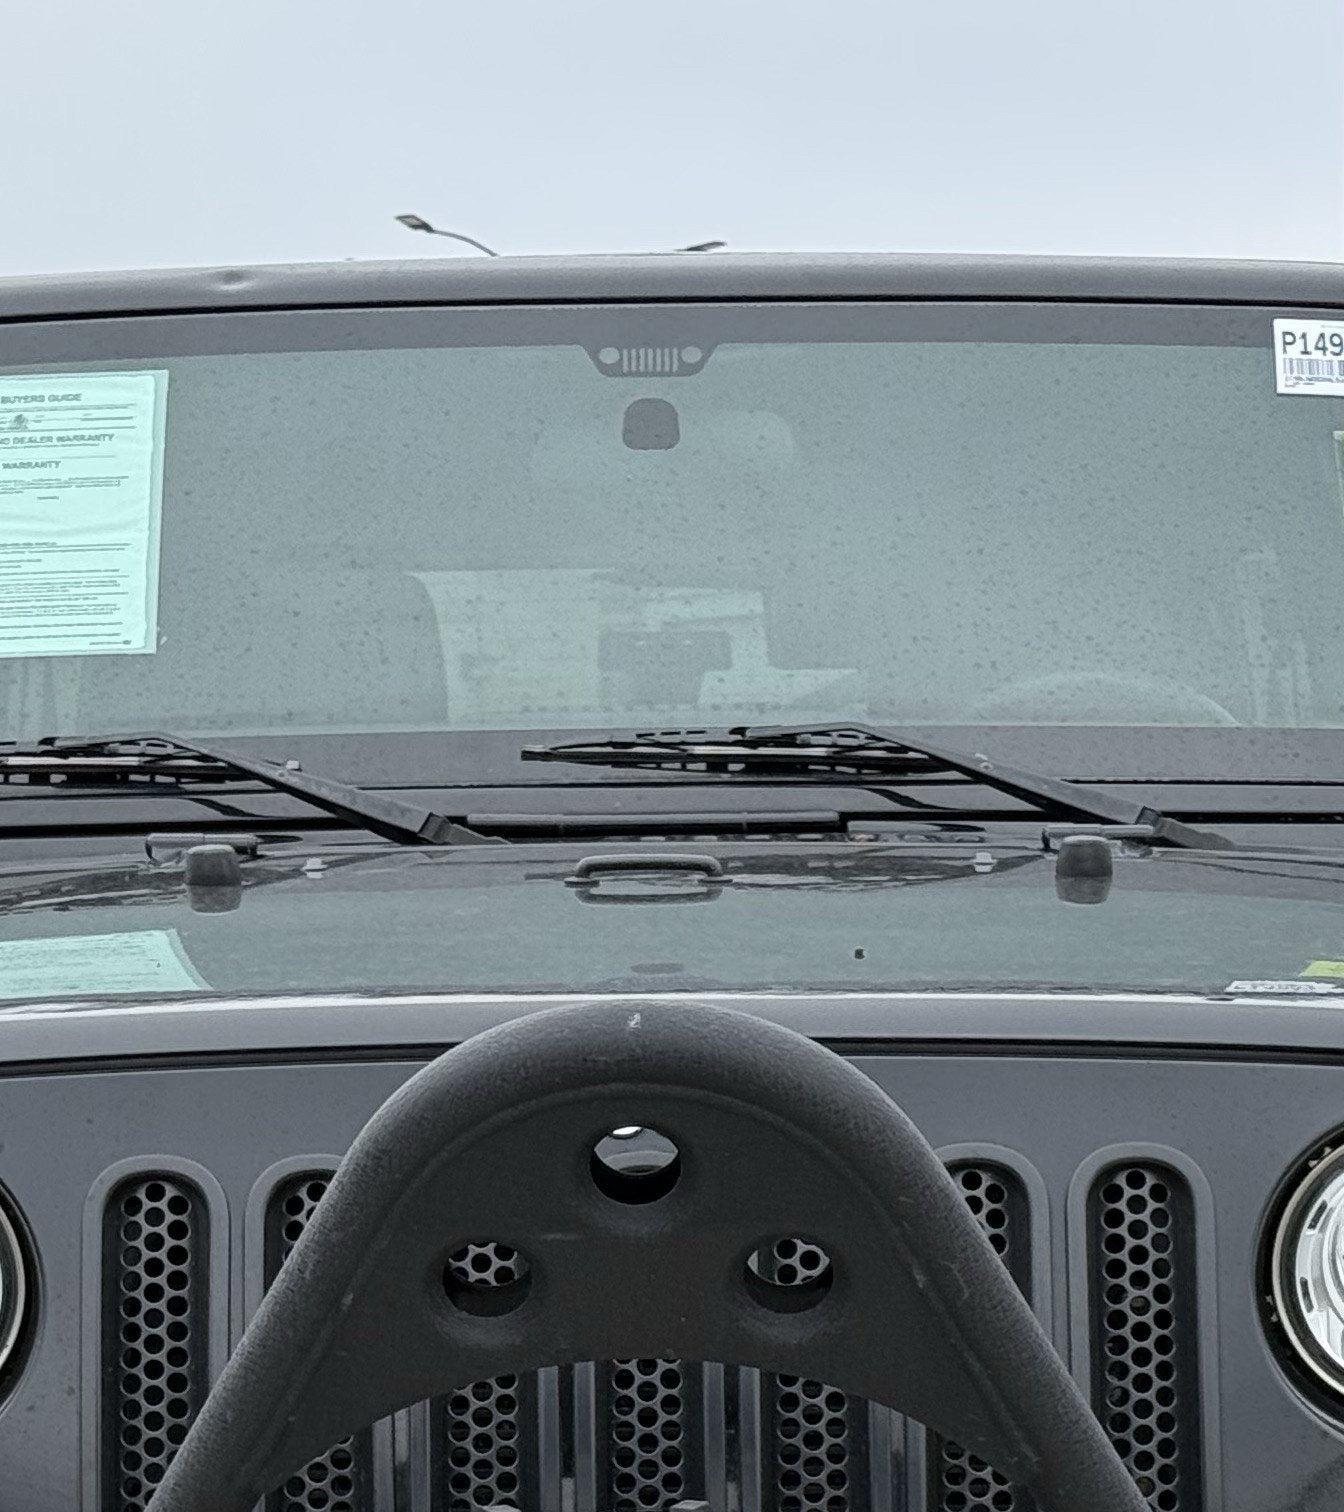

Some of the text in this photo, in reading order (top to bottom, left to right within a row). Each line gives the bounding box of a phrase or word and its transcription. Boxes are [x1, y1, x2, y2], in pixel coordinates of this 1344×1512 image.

[0, 392, 83, 405] BUYERS GUIDE
[12, 435, 54, 445] DEALER
[56, 433, 115, 443] WARRANTY
[2, 460, 62, 471] WARRANTY
